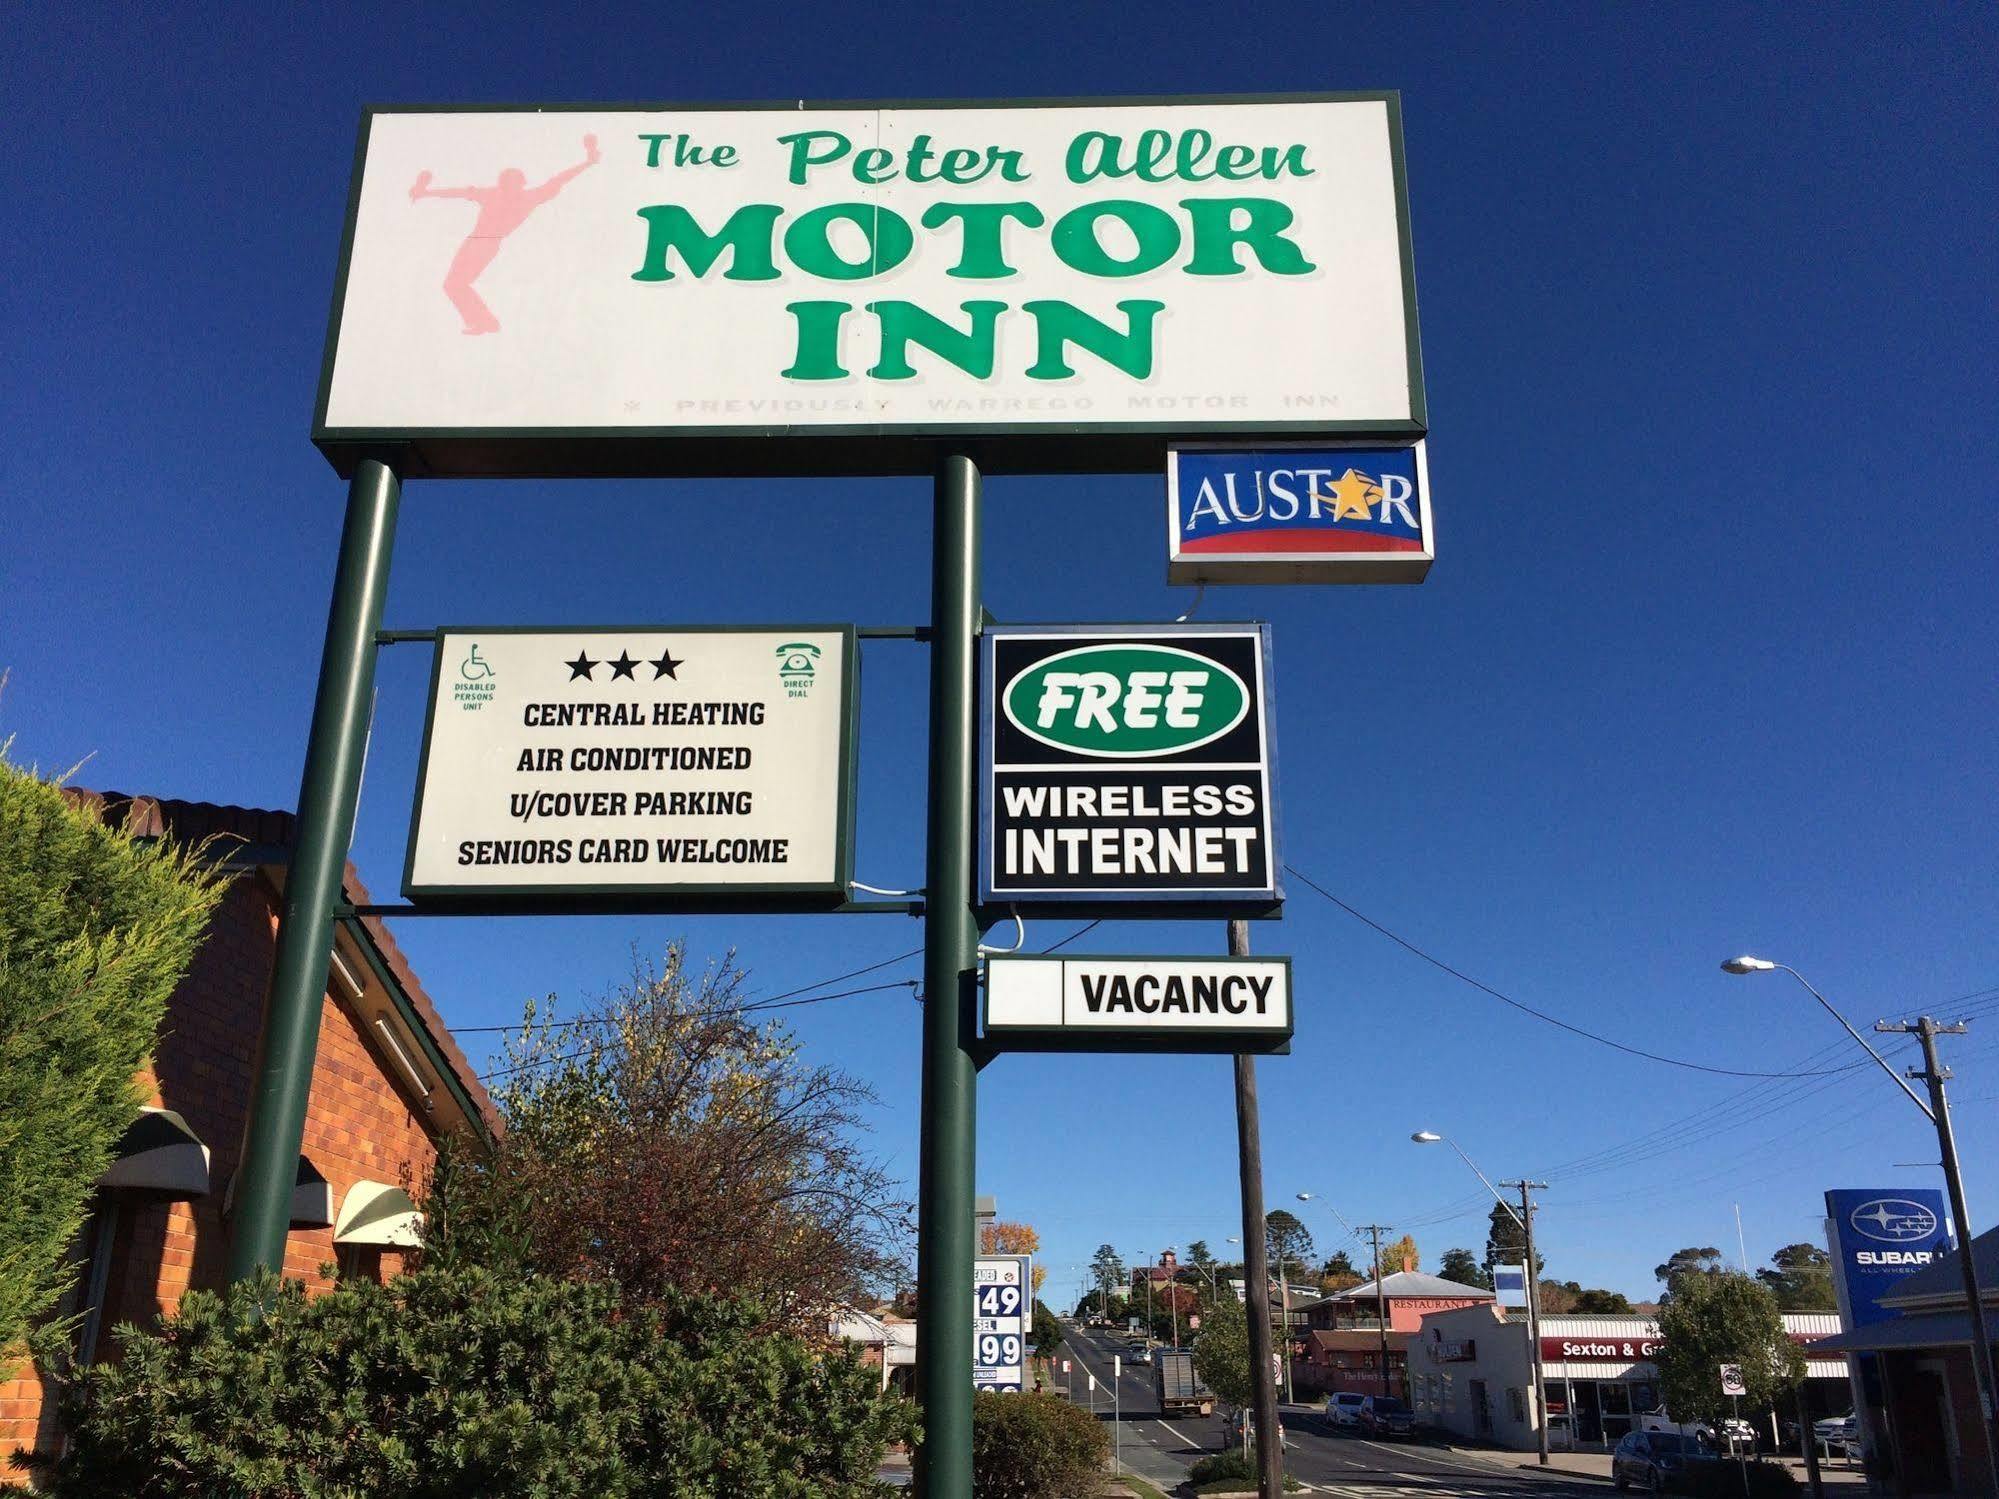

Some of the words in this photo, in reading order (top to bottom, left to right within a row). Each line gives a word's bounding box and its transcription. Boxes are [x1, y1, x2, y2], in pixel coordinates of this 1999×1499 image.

[638, 133, 739, 168] The
[777, 129, 1028, 185] Peter
[1065, 128, 1315, 184] Allen
[632, 196, 1317, 283] MOTOR
[781, 297, 1166, 381] INN
[677, 399, 890, 413] PREVIOUSLY
[928, 397, 1094, 411] WARREGO
[1127, 395, 1248, 409] MOTOR
[1284, 394, 1340, 408] INN
[454, 683, 496, 691] DISABLED
[454, 693, 494, 701] PERSONS
[783, 680, 814, 688] DIRECT
[788, 690, 808, 698] DIAL
[463, 703, 483, 711] UNIT
[523, 703, 646, 727] CENTRAL
[652, 702, 765, 726] HEATING
[1036, 669, 1210, 734] FREE
[516, 748, 564, 772] AIR
[570, 746, 752, 771] CONDITIONED
[510, 789, 627, 823] U/COVER
[634, 791, 753, 817] PARKING
[1003, 784, 1257, 817] WIRELESS
[457, 839, 573, 866] SENIORS
[578, 839, 649, 865] CARD
[656, 838, 789, 864] WELCOME
[1004, 827, 1258, 875] INTERNET
[1080, 974, 1275, 1015] VACANCY
[1856, 1251, 1943, 1264] SUBAR
[981, 1286, 1020, 1315] 49
[1393, 1300, 1467, 1309] RESTAURANT
[981, 1335, 1020, 1365] 99
[1562, 1341, 1617, 1356] Sexton
[1622, 1342, 1635, 1356] &
